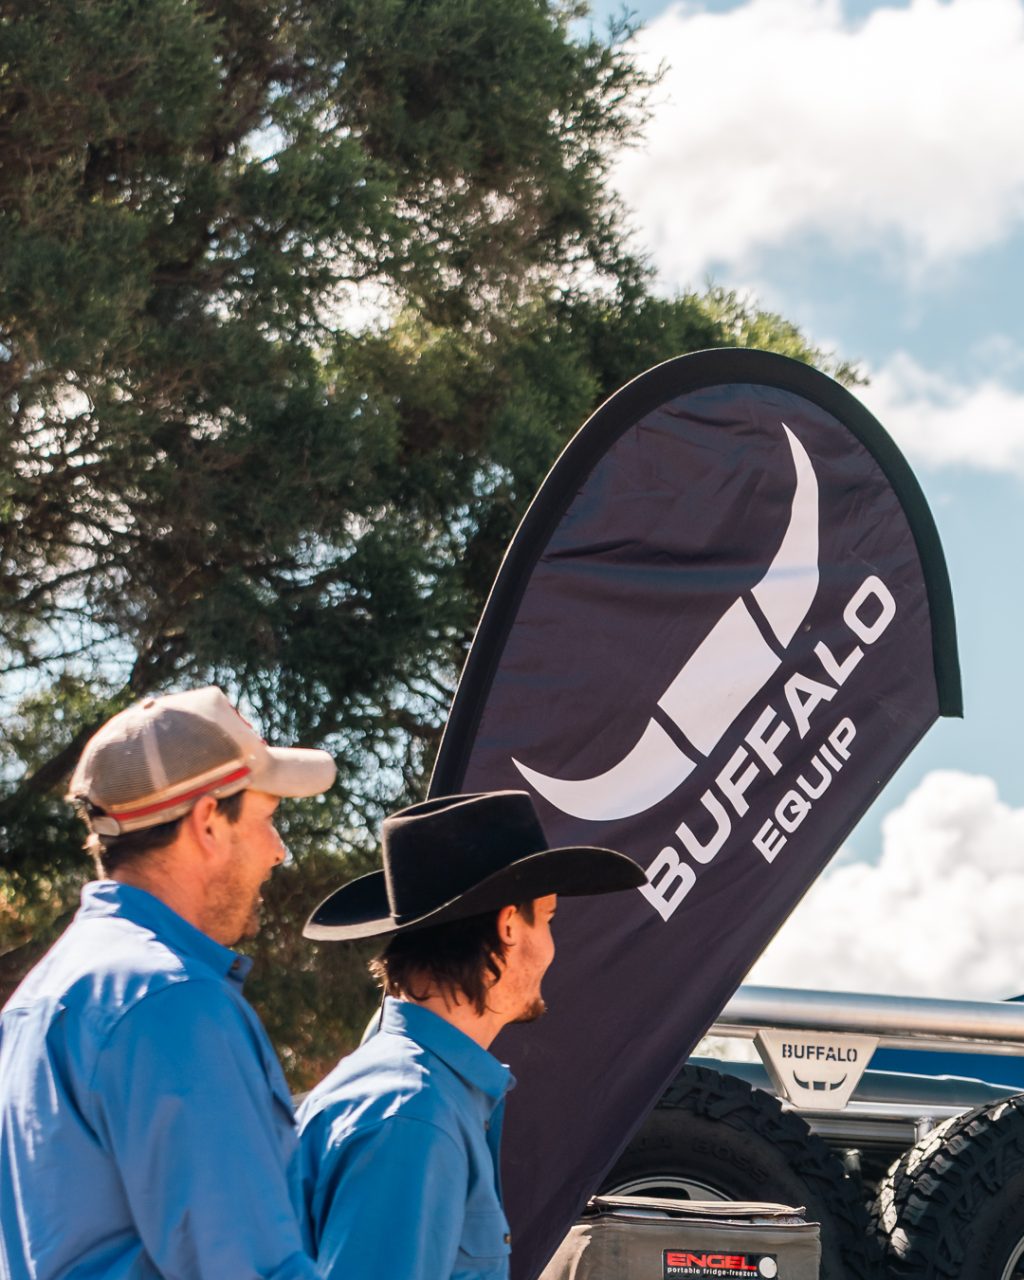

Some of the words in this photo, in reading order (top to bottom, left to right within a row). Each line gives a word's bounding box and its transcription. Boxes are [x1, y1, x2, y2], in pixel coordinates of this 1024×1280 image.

[637, 574, 896, 922] BUFFALO
[752, 716, 857, 863] EQUIP
[781, 1043, 858, 1062] BUFFALO
[666, 1252, 757, 1271] ENGEL
[703, 1268, 758, 1277] fridge-freezers
